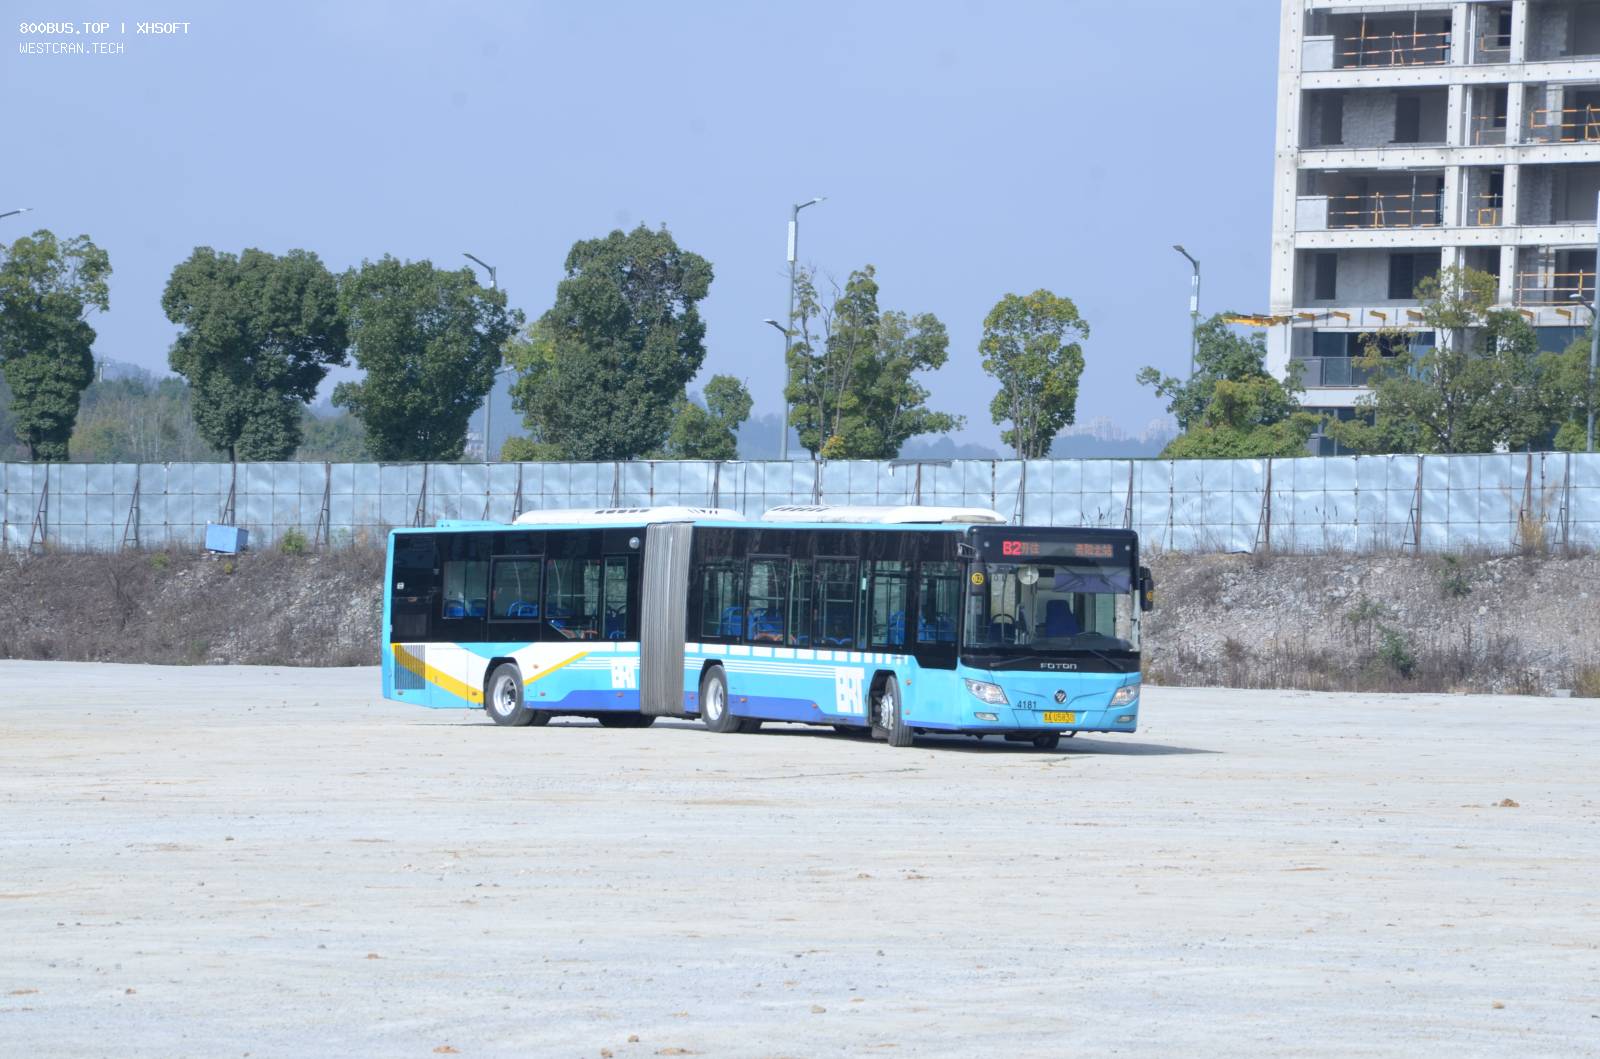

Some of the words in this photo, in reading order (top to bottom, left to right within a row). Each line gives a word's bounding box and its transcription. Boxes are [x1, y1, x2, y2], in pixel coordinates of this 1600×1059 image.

[1002, 541, 1022, 555] B2
[1040, 662, 1078, 670] FOTON
[835, 666, 865, 714] BRT
[1017, 701, 1037, 710] 4181
